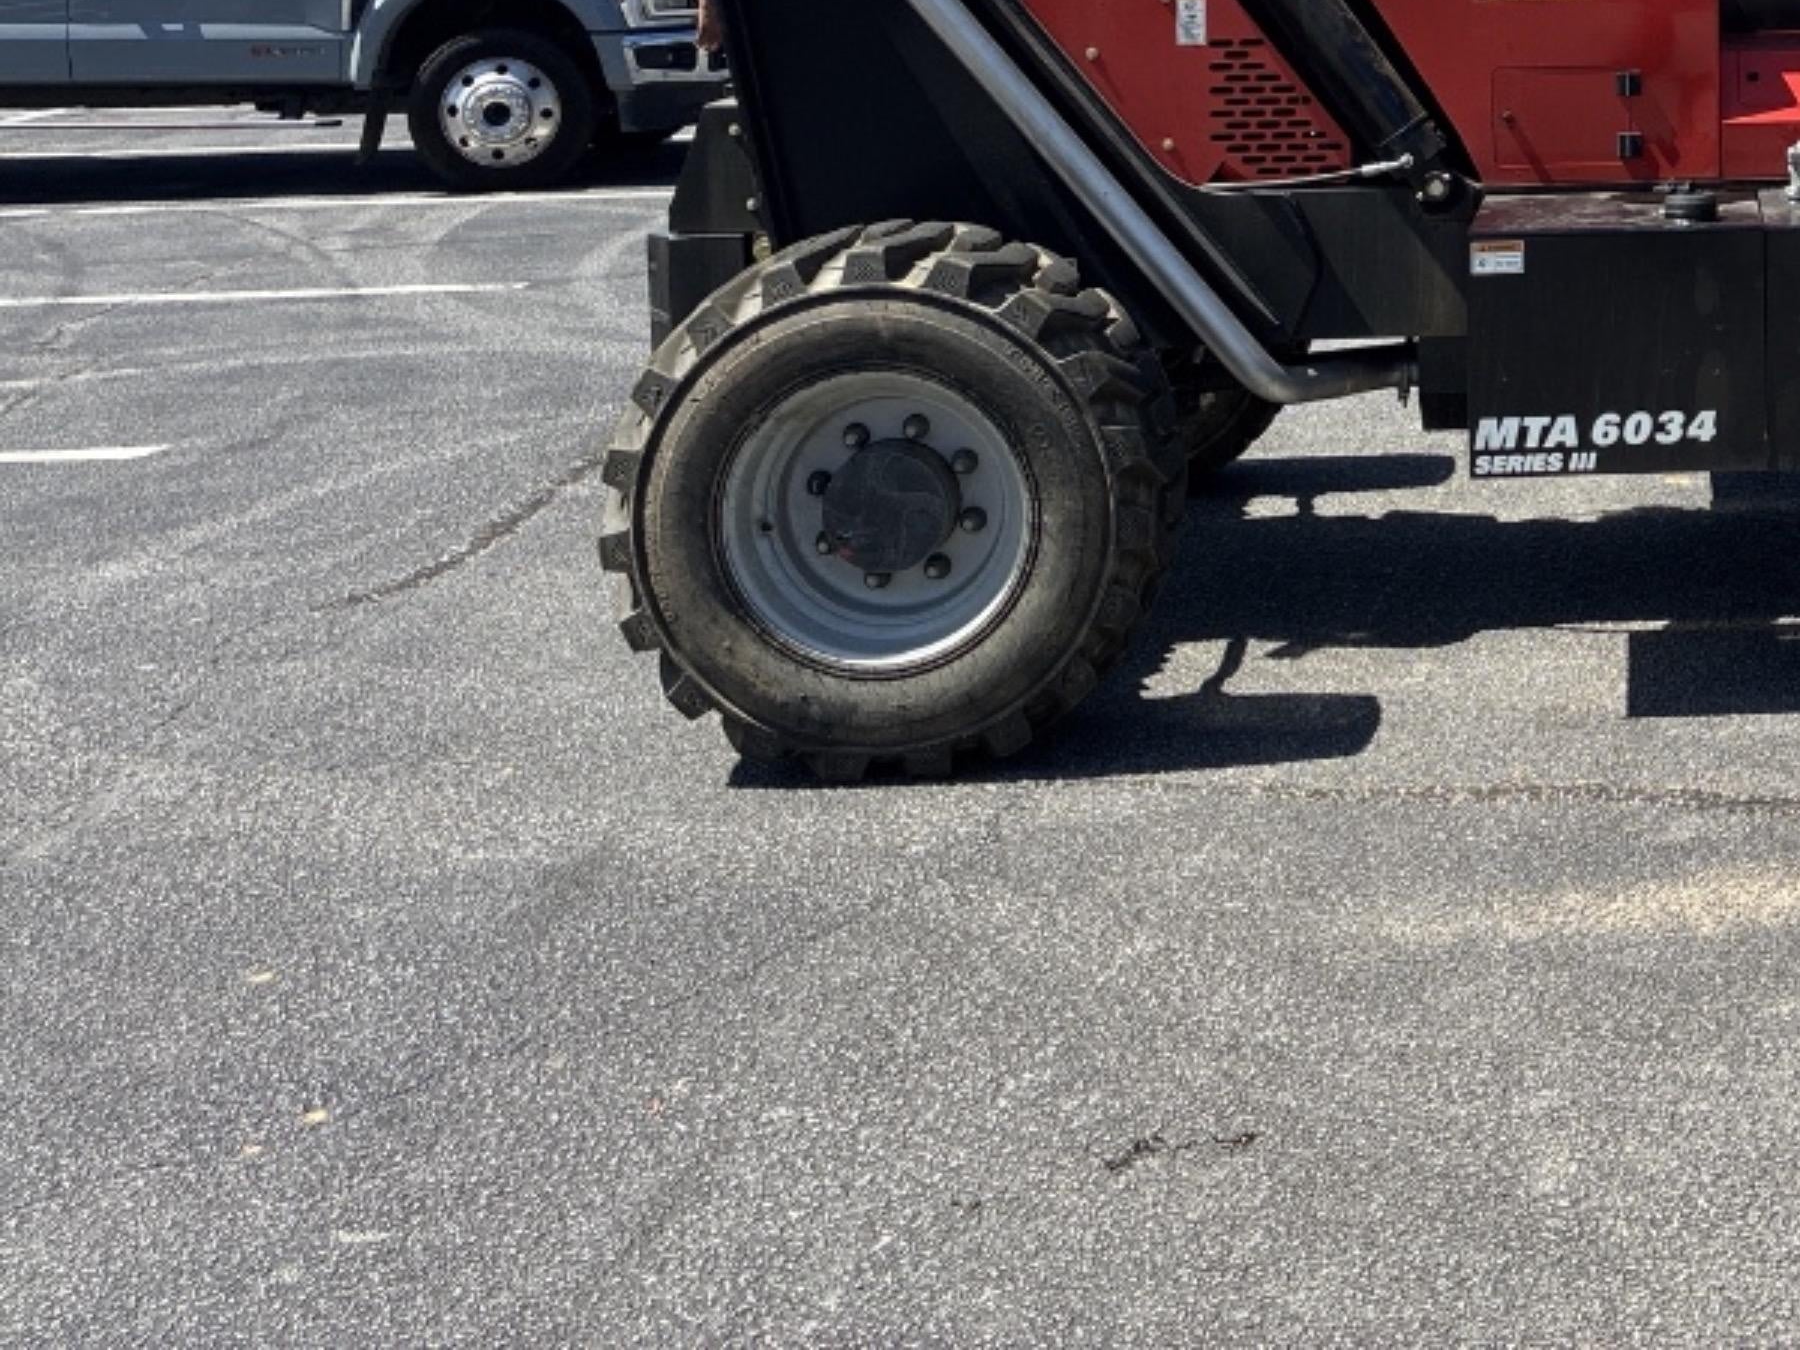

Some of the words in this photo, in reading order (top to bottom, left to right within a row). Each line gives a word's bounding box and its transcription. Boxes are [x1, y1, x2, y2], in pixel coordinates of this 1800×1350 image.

[1474, 414, 1580, 451] MTA
[1591, 409, 1718, 447] 6034
[1474, 452, 1564, 476] SERIES
[1568, 451, 1598, 473] III
